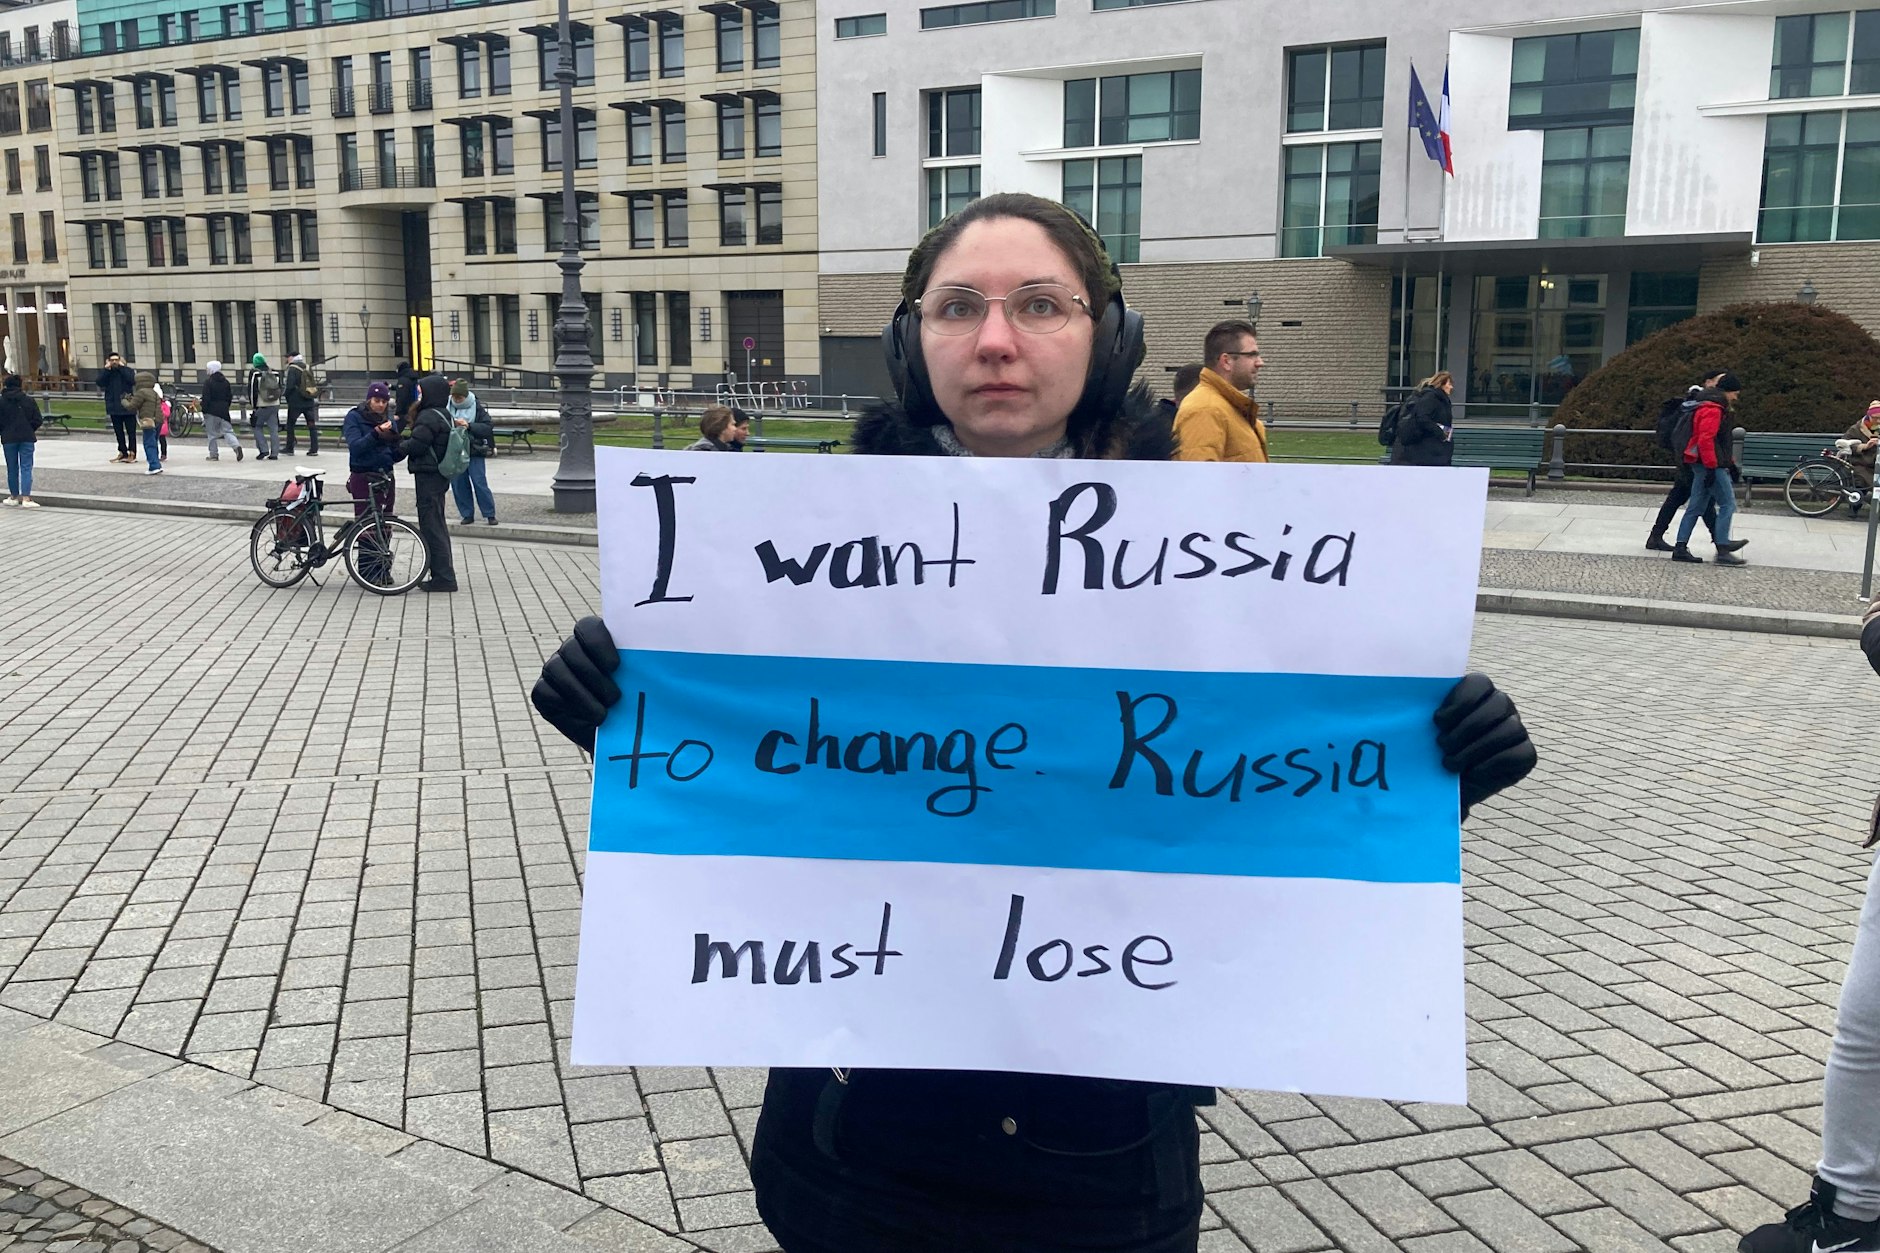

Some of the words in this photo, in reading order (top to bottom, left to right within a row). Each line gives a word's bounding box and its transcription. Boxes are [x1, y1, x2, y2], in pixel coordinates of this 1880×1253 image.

[629, 474, 697, 608] I
[754, 502, 976, 589] want
[1041, 482, 1356, 595] Russia
[608, 691, 714, 789] to
[754, 696, 1046, 818] change.
[1107, 690, 1389, 803] Russia
[691, 902, 903, 985] must
[993, 894, 1180, 990] lose
